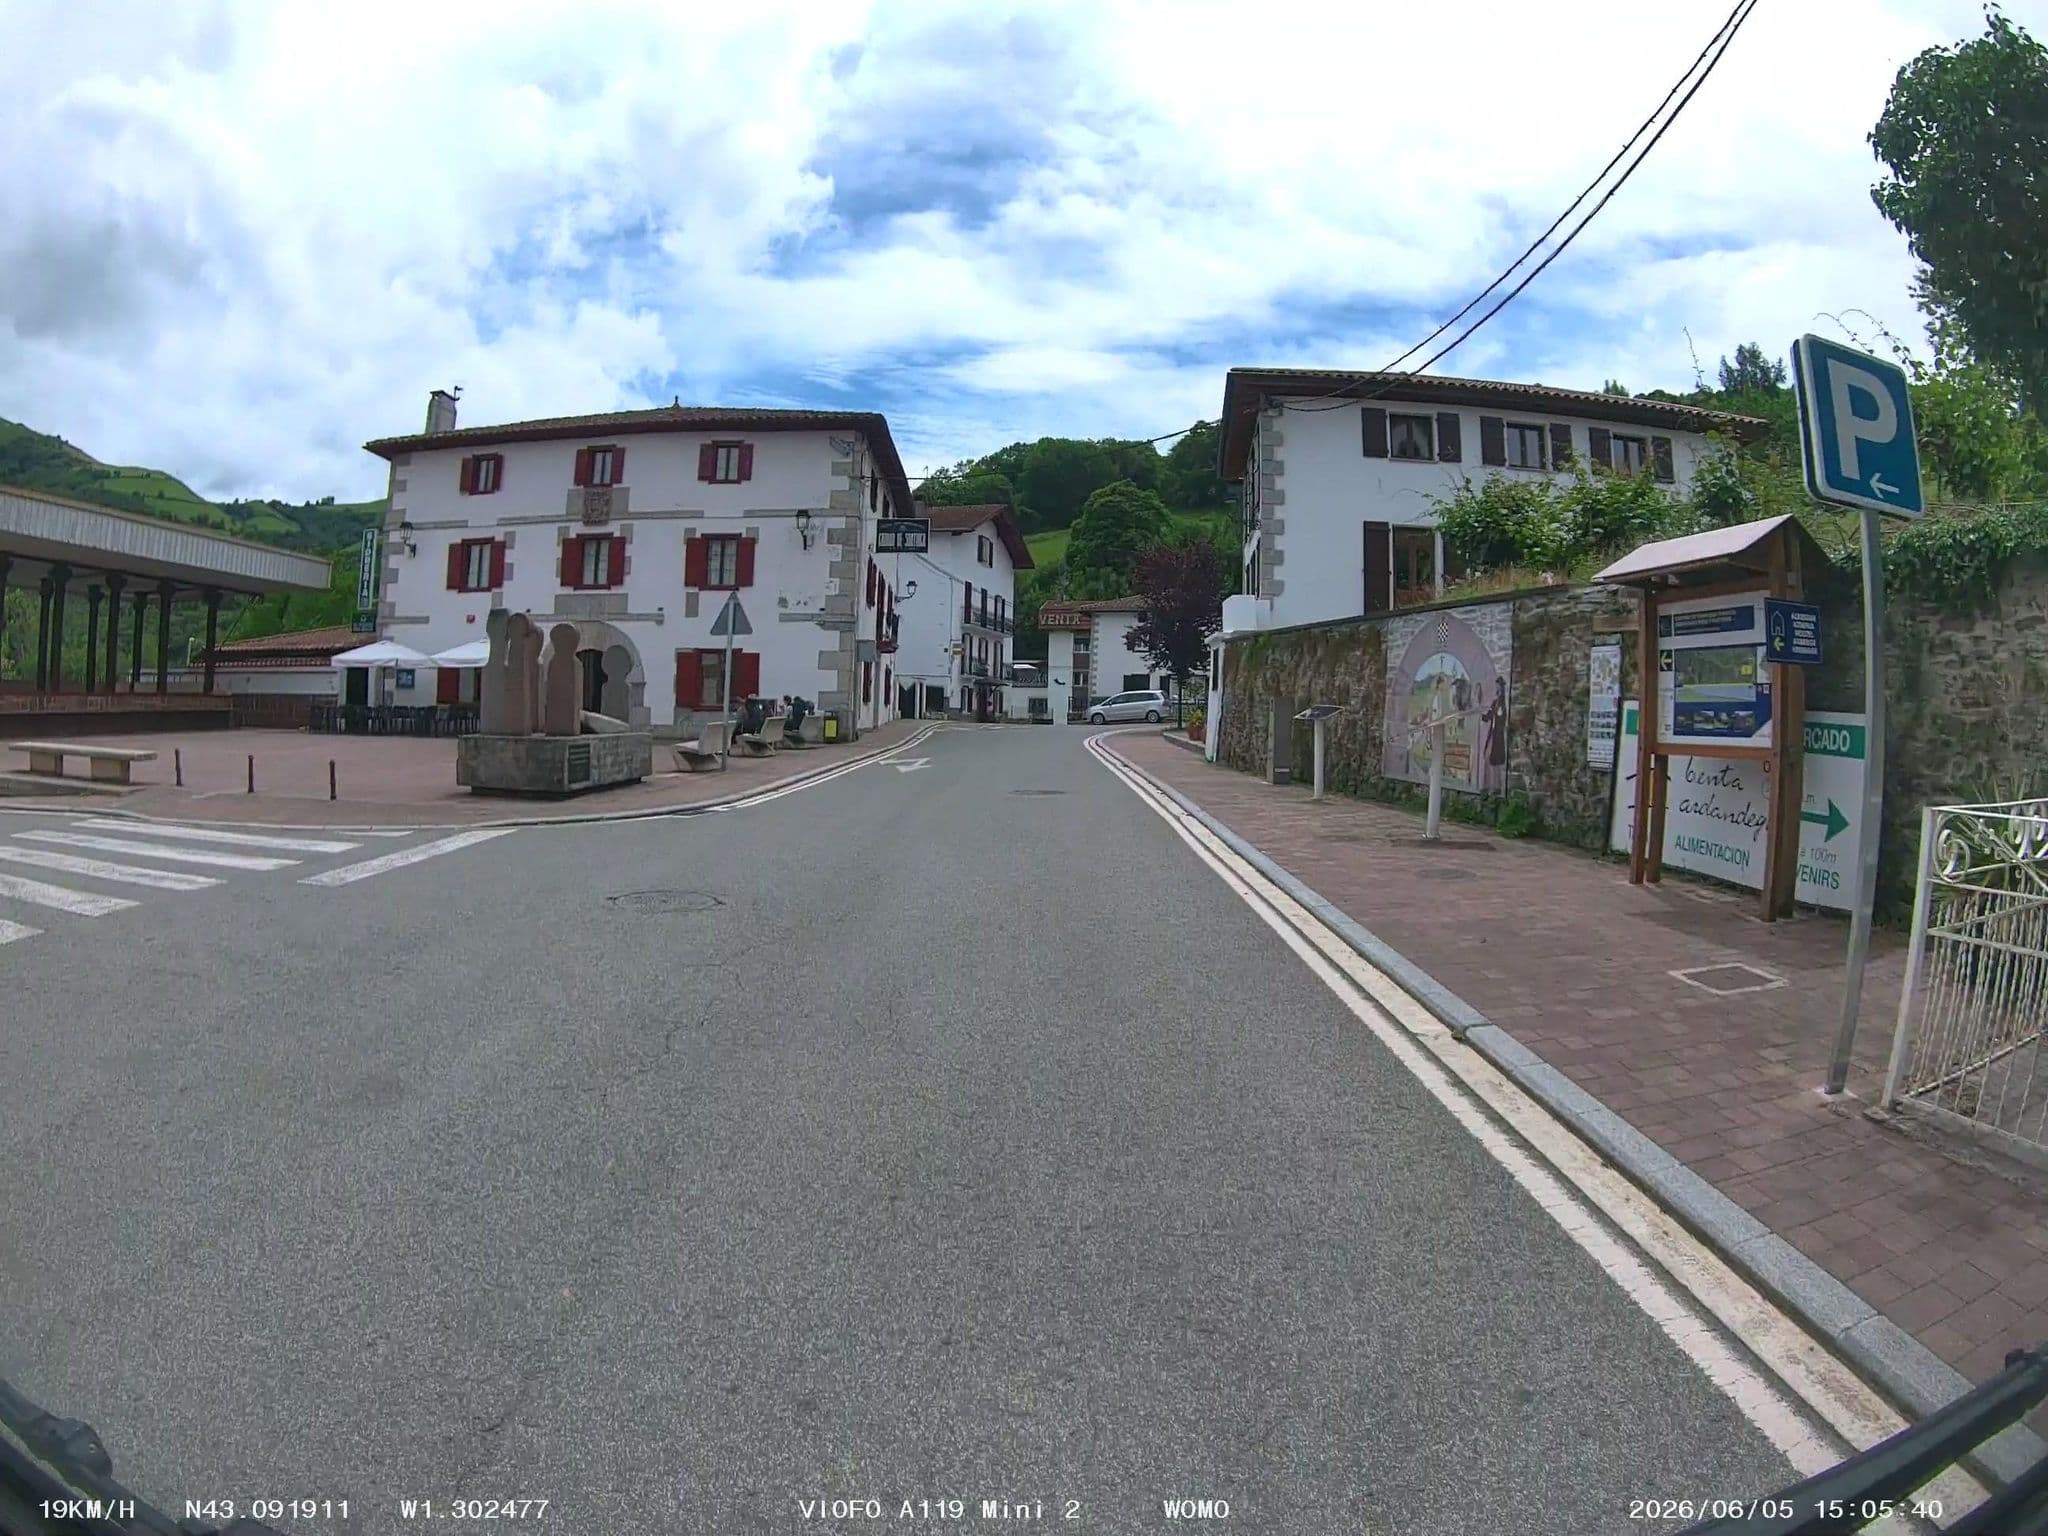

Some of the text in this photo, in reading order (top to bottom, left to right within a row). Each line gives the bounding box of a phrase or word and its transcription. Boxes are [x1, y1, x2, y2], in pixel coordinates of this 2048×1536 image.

[1827, 358, 1898, 479] P
[1040, 613, 1081, 625] VENTA
[1803, 727, 1850, 752] RCADO
[1679, 793, 1769, 842] ardandeg
[1675, 834, 1750, 867] ALIMENTACION
